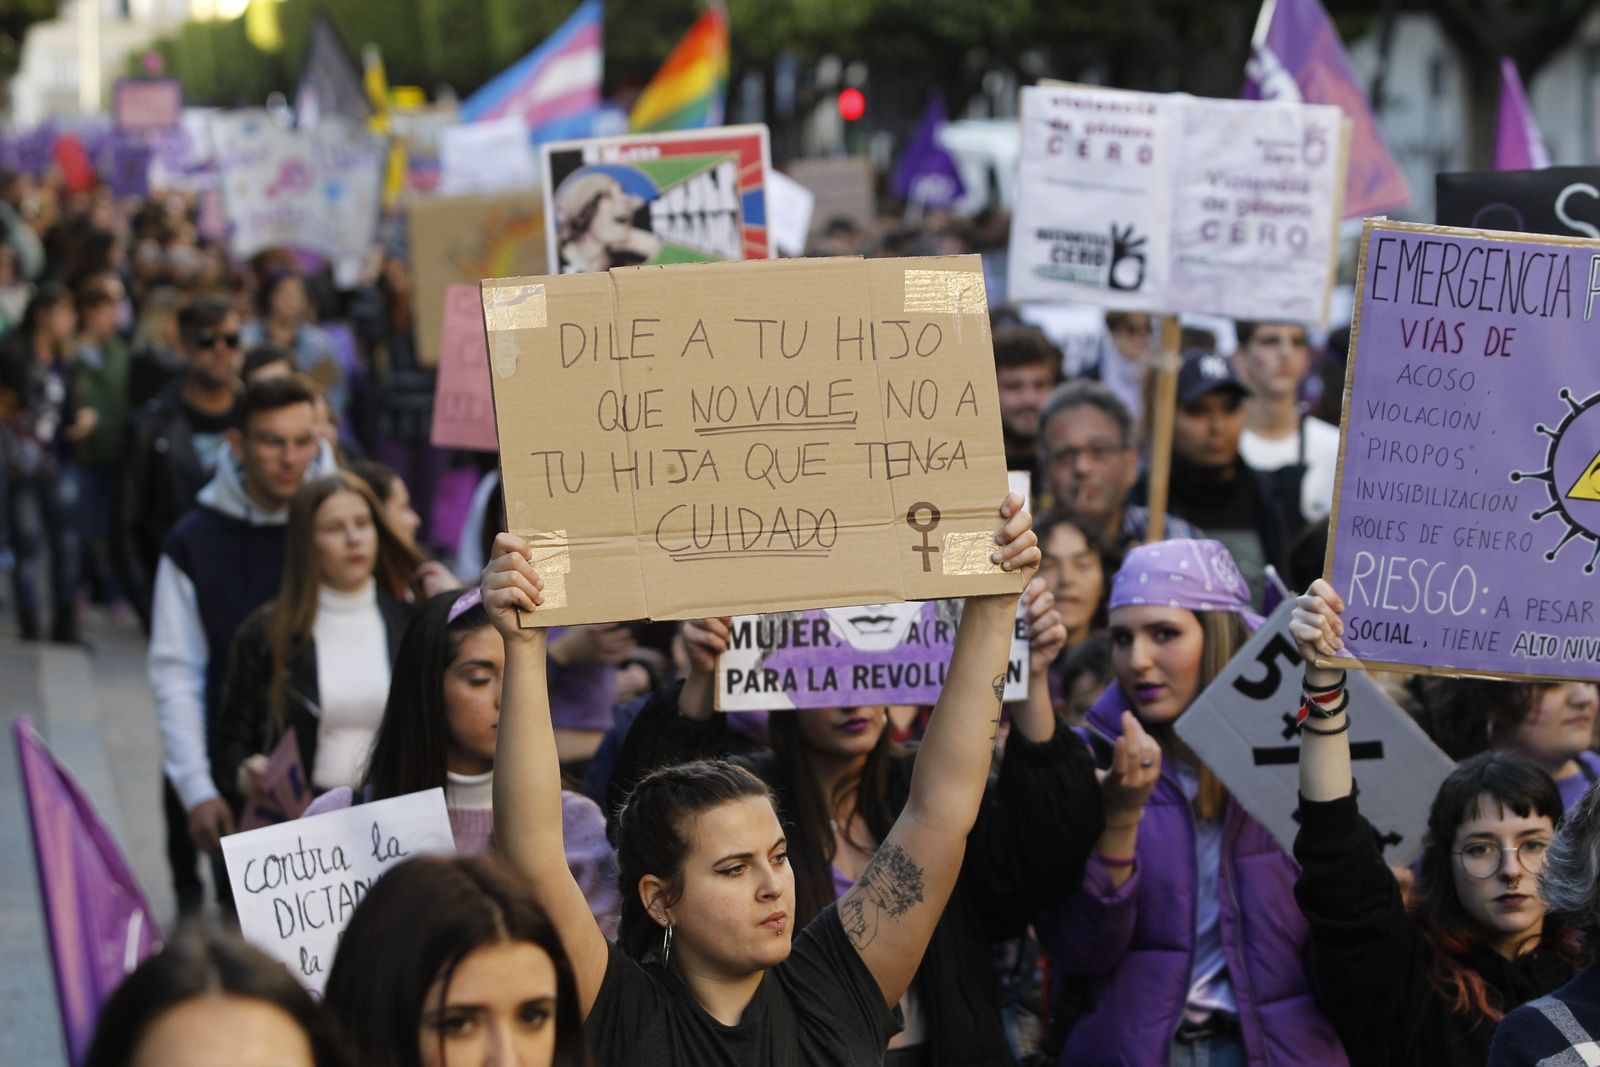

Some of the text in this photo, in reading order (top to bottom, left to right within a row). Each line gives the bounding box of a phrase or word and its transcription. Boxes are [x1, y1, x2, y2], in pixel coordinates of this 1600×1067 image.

[1200, 219, 1309, 250] CERO
[1371, 237, 1571, 318] EMERGENCIA
[559, 316, 943, 369] DILE A TU HIJO
[1400, 316, 1517, 357] VÍAS DE
[598, 388, 664, 432] QUE
[886, 379, 939, 420] NO
[955, 380, 979, 417] A
[531, 439, 968, 498] TU HIJA QUE TENGA
[655, 503, 839, 554] CUIDADO
[1351, 516, 1408, 543] ROLES
[1419, 523, 1443, 545] DE
[1494, 595, 1510, 619] A
[1526, 597, 1595, 624] PESAR
[1442, 627, 1501, 652] TIENE
[1511, 631, 1560, 658] ALTO
[726, 667, 798, 695] PARA
[807, 666, 838, 692] LA
[244, 821, 409, 894] contra la
[299, 946, 323, 976] la
